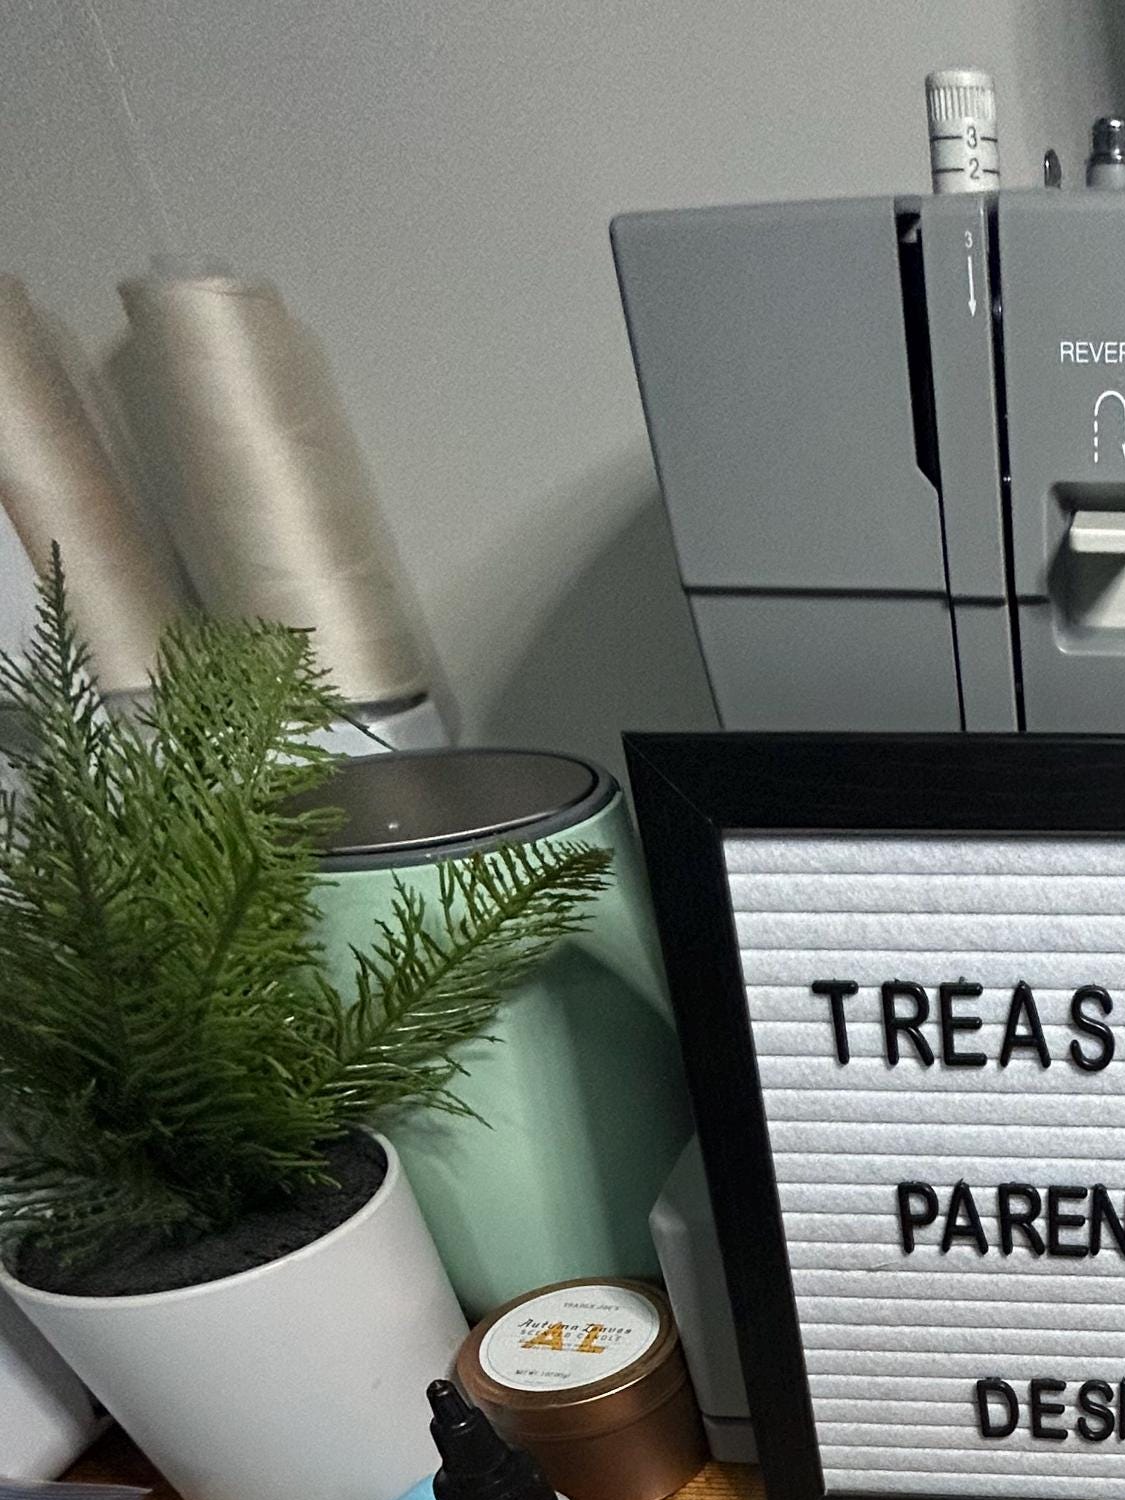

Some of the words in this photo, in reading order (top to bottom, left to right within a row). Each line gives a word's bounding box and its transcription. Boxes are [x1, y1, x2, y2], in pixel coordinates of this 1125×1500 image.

[967, 126, 977, 149] 3
[968, 157, 980, 180] 2
[964, 230, 973, 248] 3
